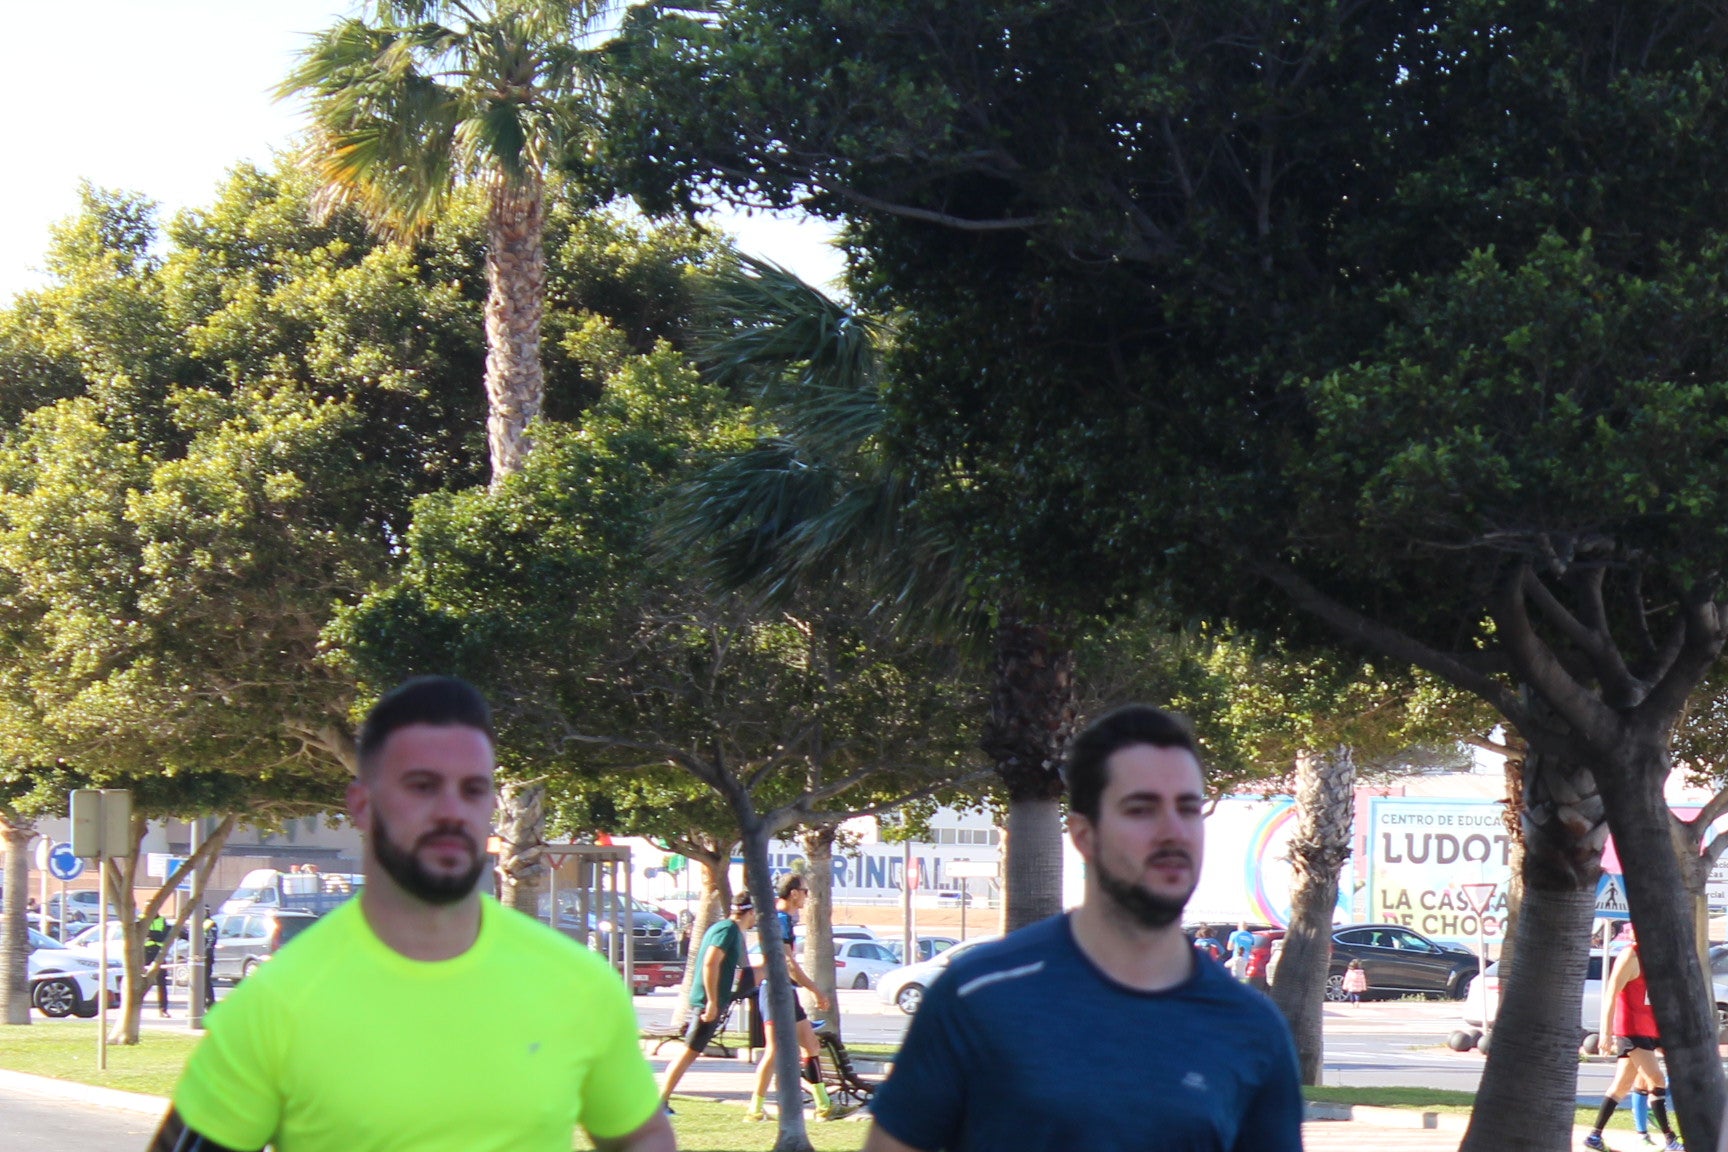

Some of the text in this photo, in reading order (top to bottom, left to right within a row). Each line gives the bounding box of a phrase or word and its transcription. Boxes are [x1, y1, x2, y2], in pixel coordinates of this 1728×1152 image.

[1381, 814, 1501, 827] CENTRO DE EDUCA
[1381, 889, 1412, 910] LA
